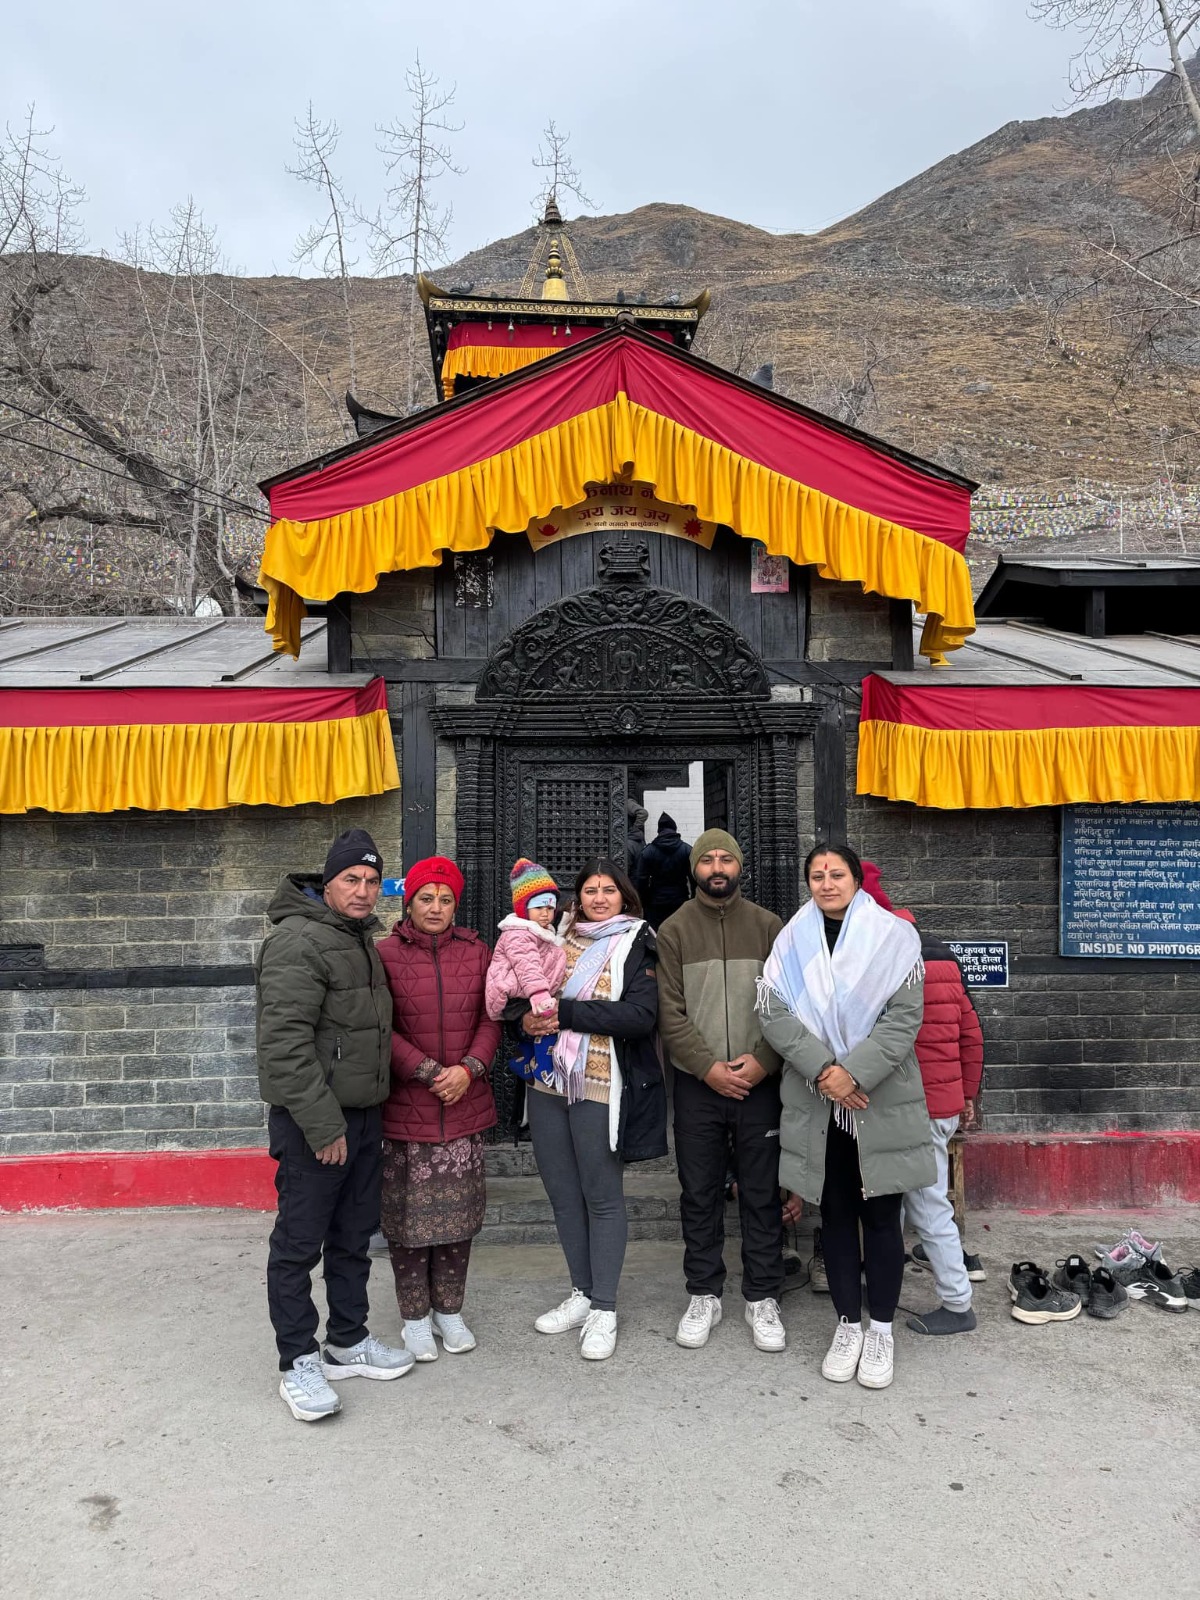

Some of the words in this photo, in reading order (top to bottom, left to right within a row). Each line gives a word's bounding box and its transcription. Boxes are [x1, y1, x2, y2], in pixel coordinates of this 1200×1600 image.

[576, 506, 604, 520] जय
[610, 505, 638, 516] जय
[643, 508, 672, 523] जय
[1080, 943, 1124, 954] INSIDE
[1128, 944, 1144, 954] NO
